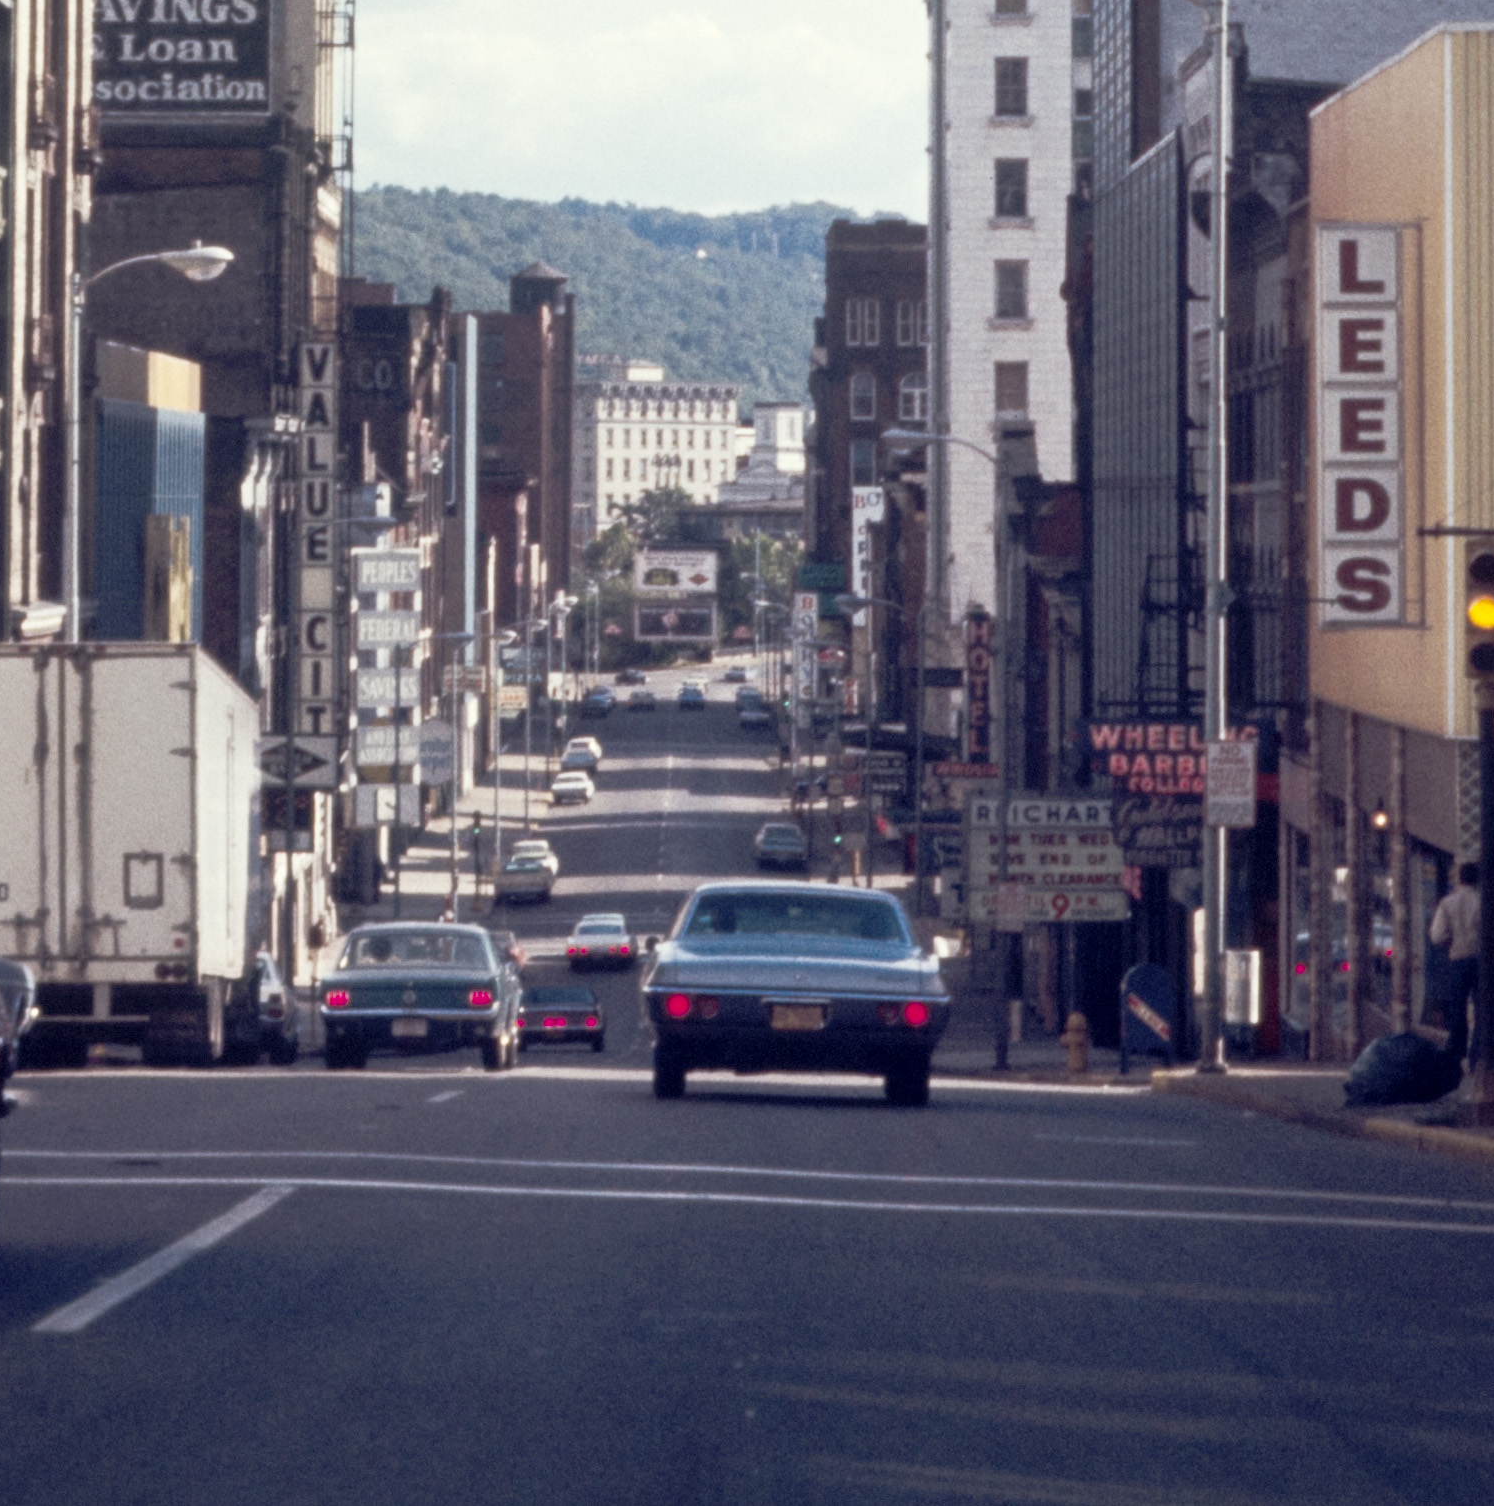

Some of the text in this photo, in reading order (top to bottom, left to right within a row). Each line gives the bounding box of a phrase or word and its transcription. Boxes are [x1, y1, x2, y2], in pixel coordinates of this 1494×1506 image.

[118, 34, 238, 62] Loan
[95, 73, 268, 101] sociation
[1335, 239, 1392, 613] LEEDS
[305, 346, 332, 734] VALUE CIT
[362, 560, 417, 585] PEOPLES
[1090, 725, 1260, 750] WHEELNG
[1109, 754, 1207, 776] BARB
[1051, 894, 1070, 921] 9
